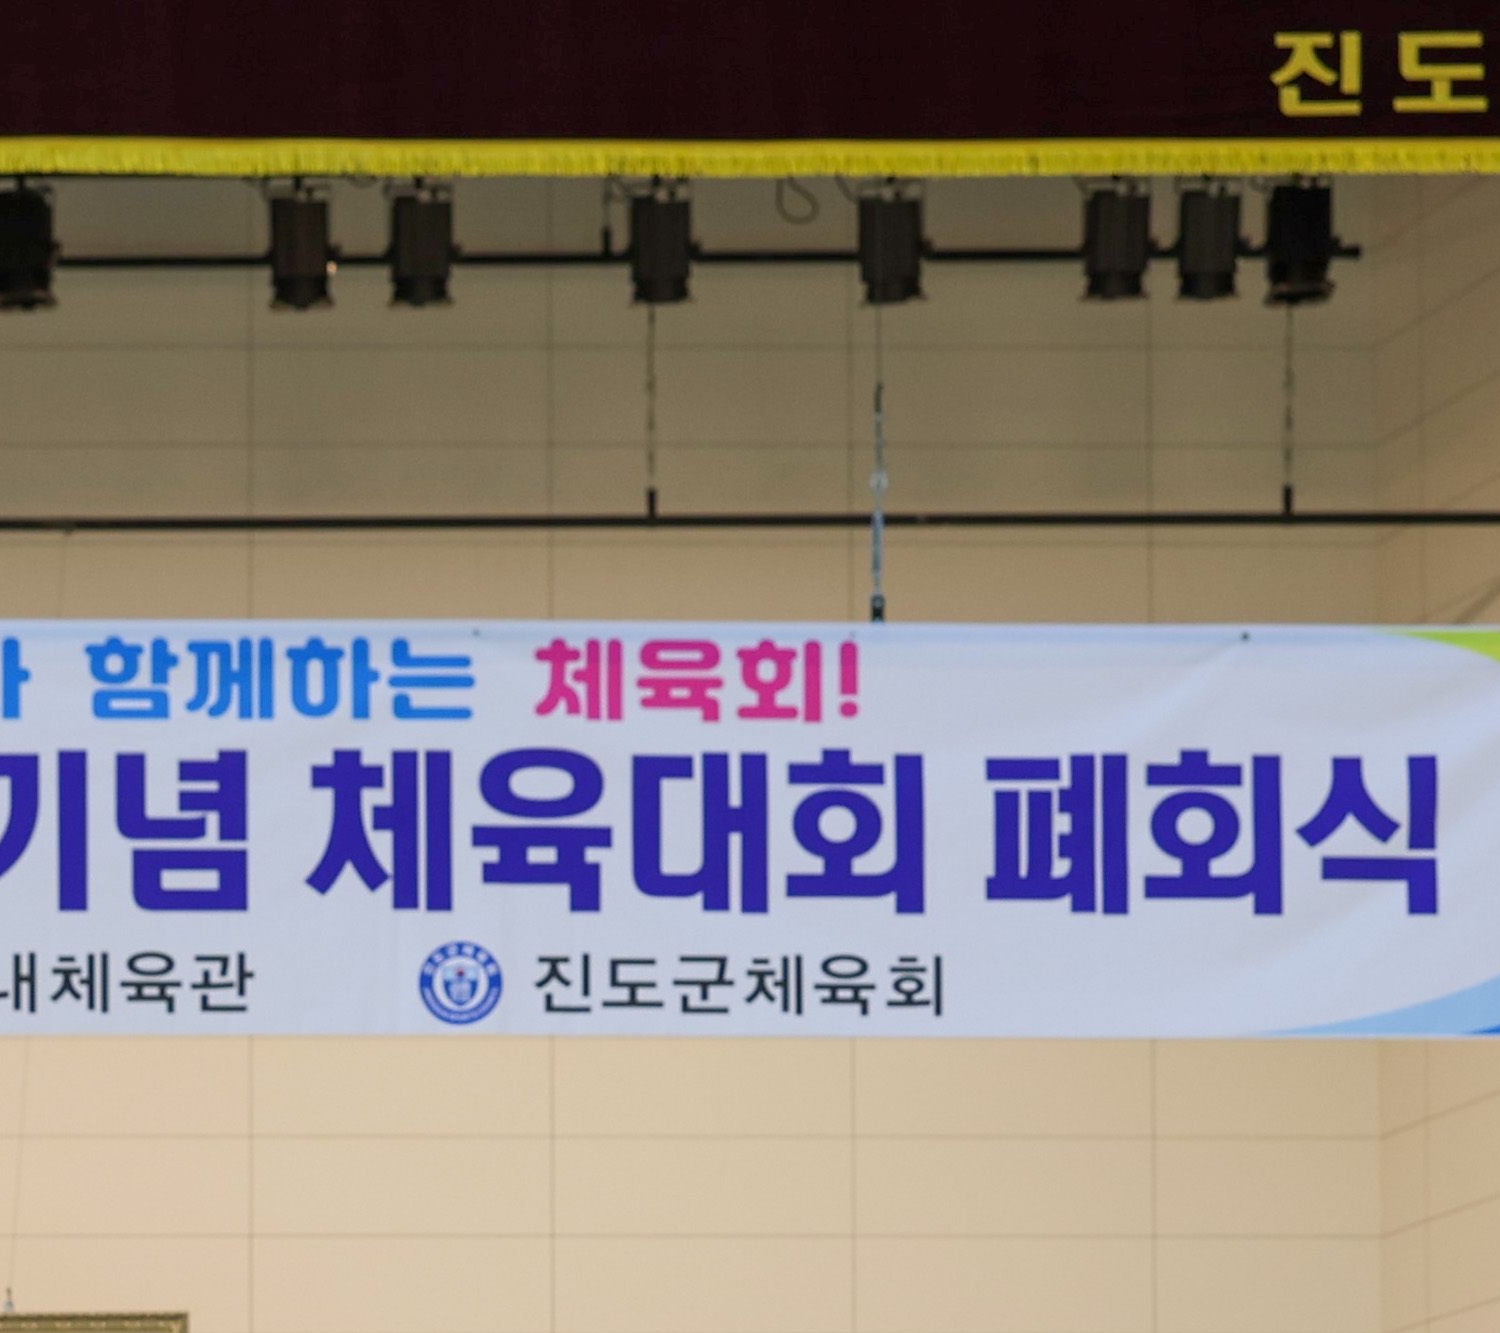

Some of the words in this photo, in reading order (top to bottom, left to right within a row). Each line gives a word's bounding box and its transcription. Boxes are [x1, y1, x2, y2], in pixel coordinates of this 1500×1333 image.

[85, 636, 474, 721] 함께하는
[535, 636, 859, 722] 체육회!
[304, 747, 925, 914] 체육대회
[984, 749, 1440, 915] 폐회식
[534, 950, 945, 1016] 진도군체육회
